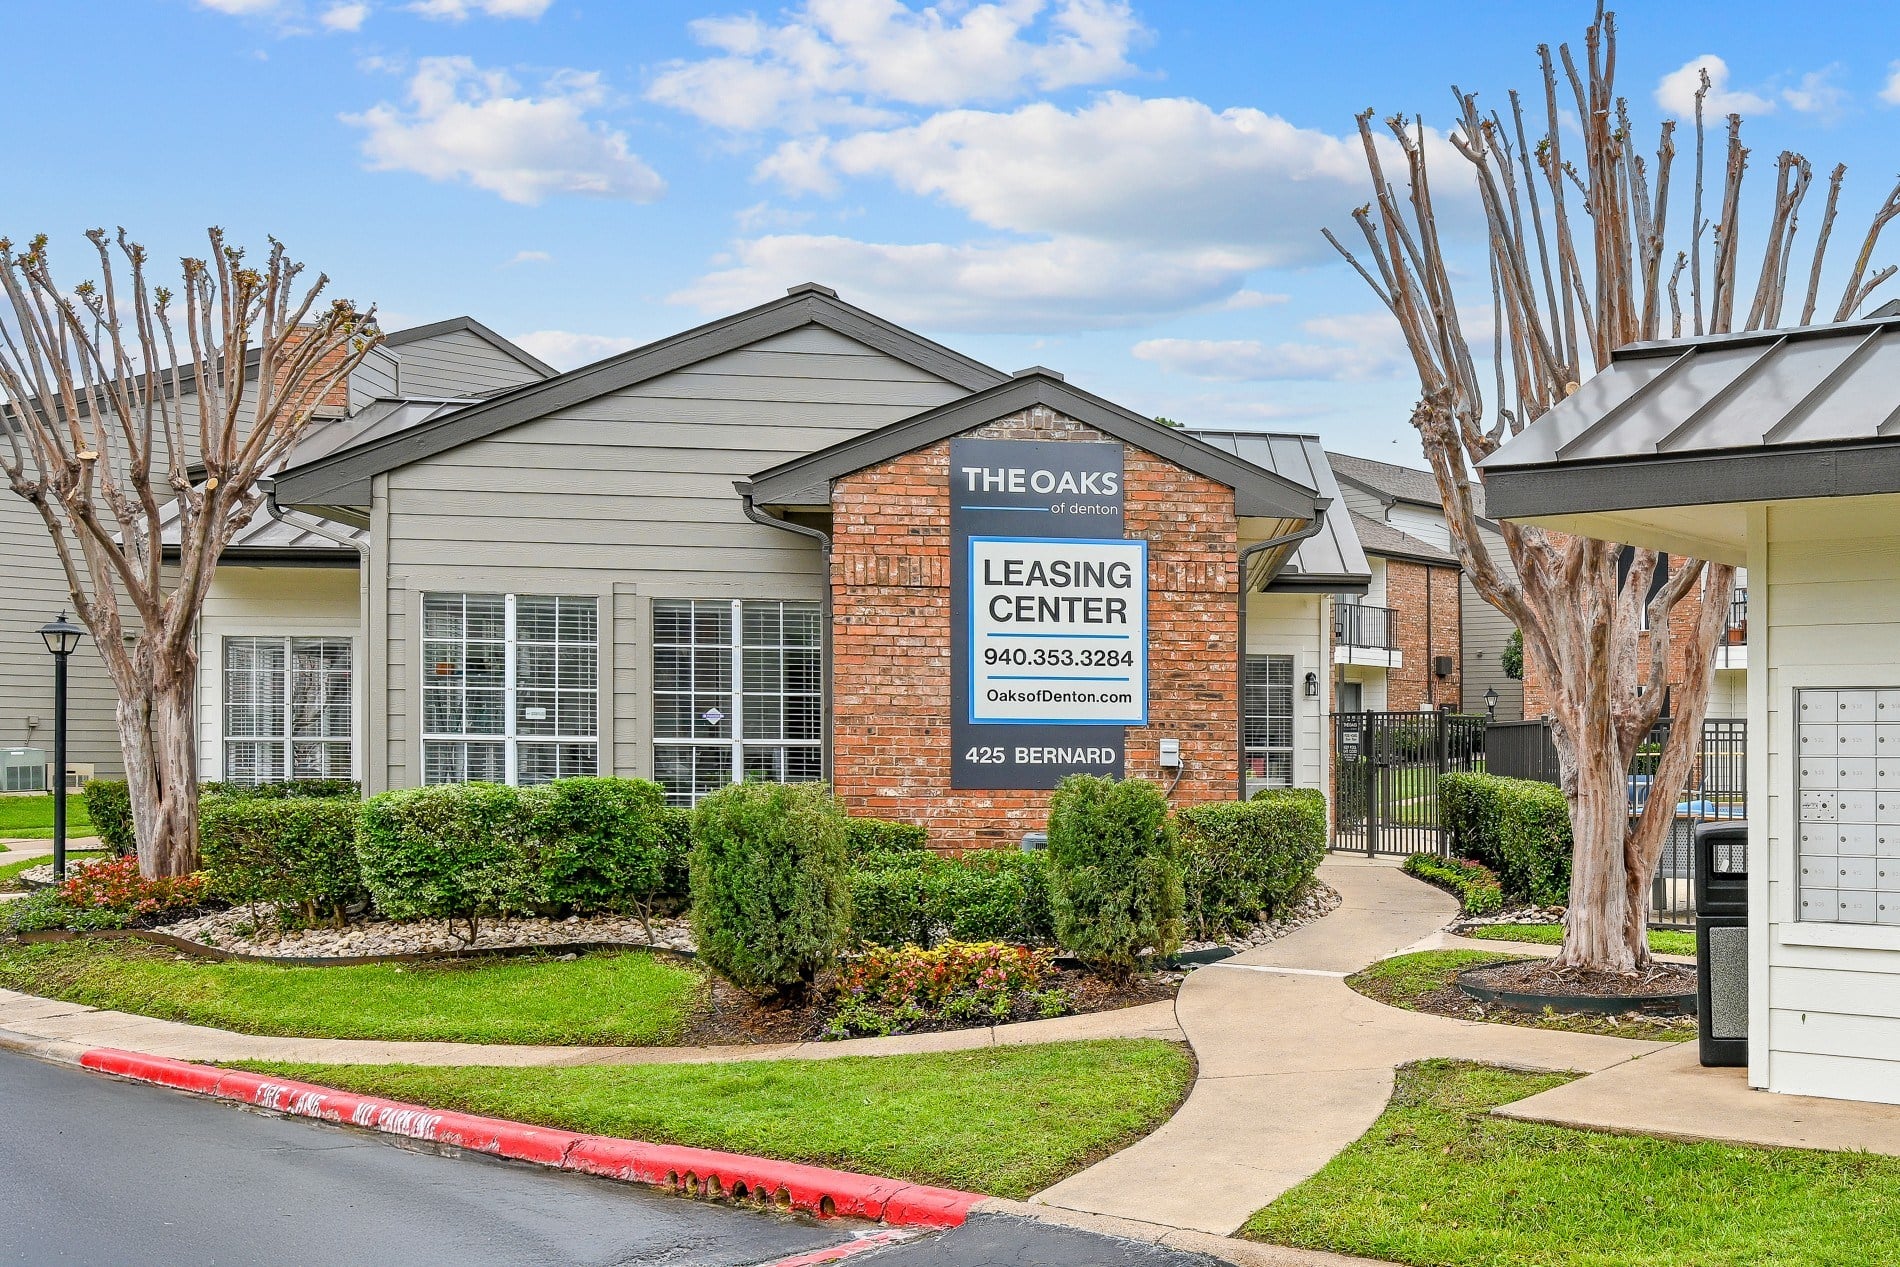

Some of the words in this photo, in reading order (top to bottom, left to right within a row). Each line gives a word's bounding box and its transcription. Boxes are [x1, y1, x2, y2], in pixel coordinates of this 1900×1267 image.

[961, 466, 1026, 493] THE
[1030, 469, 1119, 496] OAKS
[1050, 502, 1066, 515] of
[1069, 502, 1119, 516] denton
[984, 558, 1132, 589] LEASING
[988, 594, 1127, 624] CENTER
[984, 647, 1134, 668] 940.353.3284
[986, 688, 1132, 705] OaksofDenton.com
[965, 746, 1005, 764] 425
[1014, 746, 1116, 765] BERNARD
